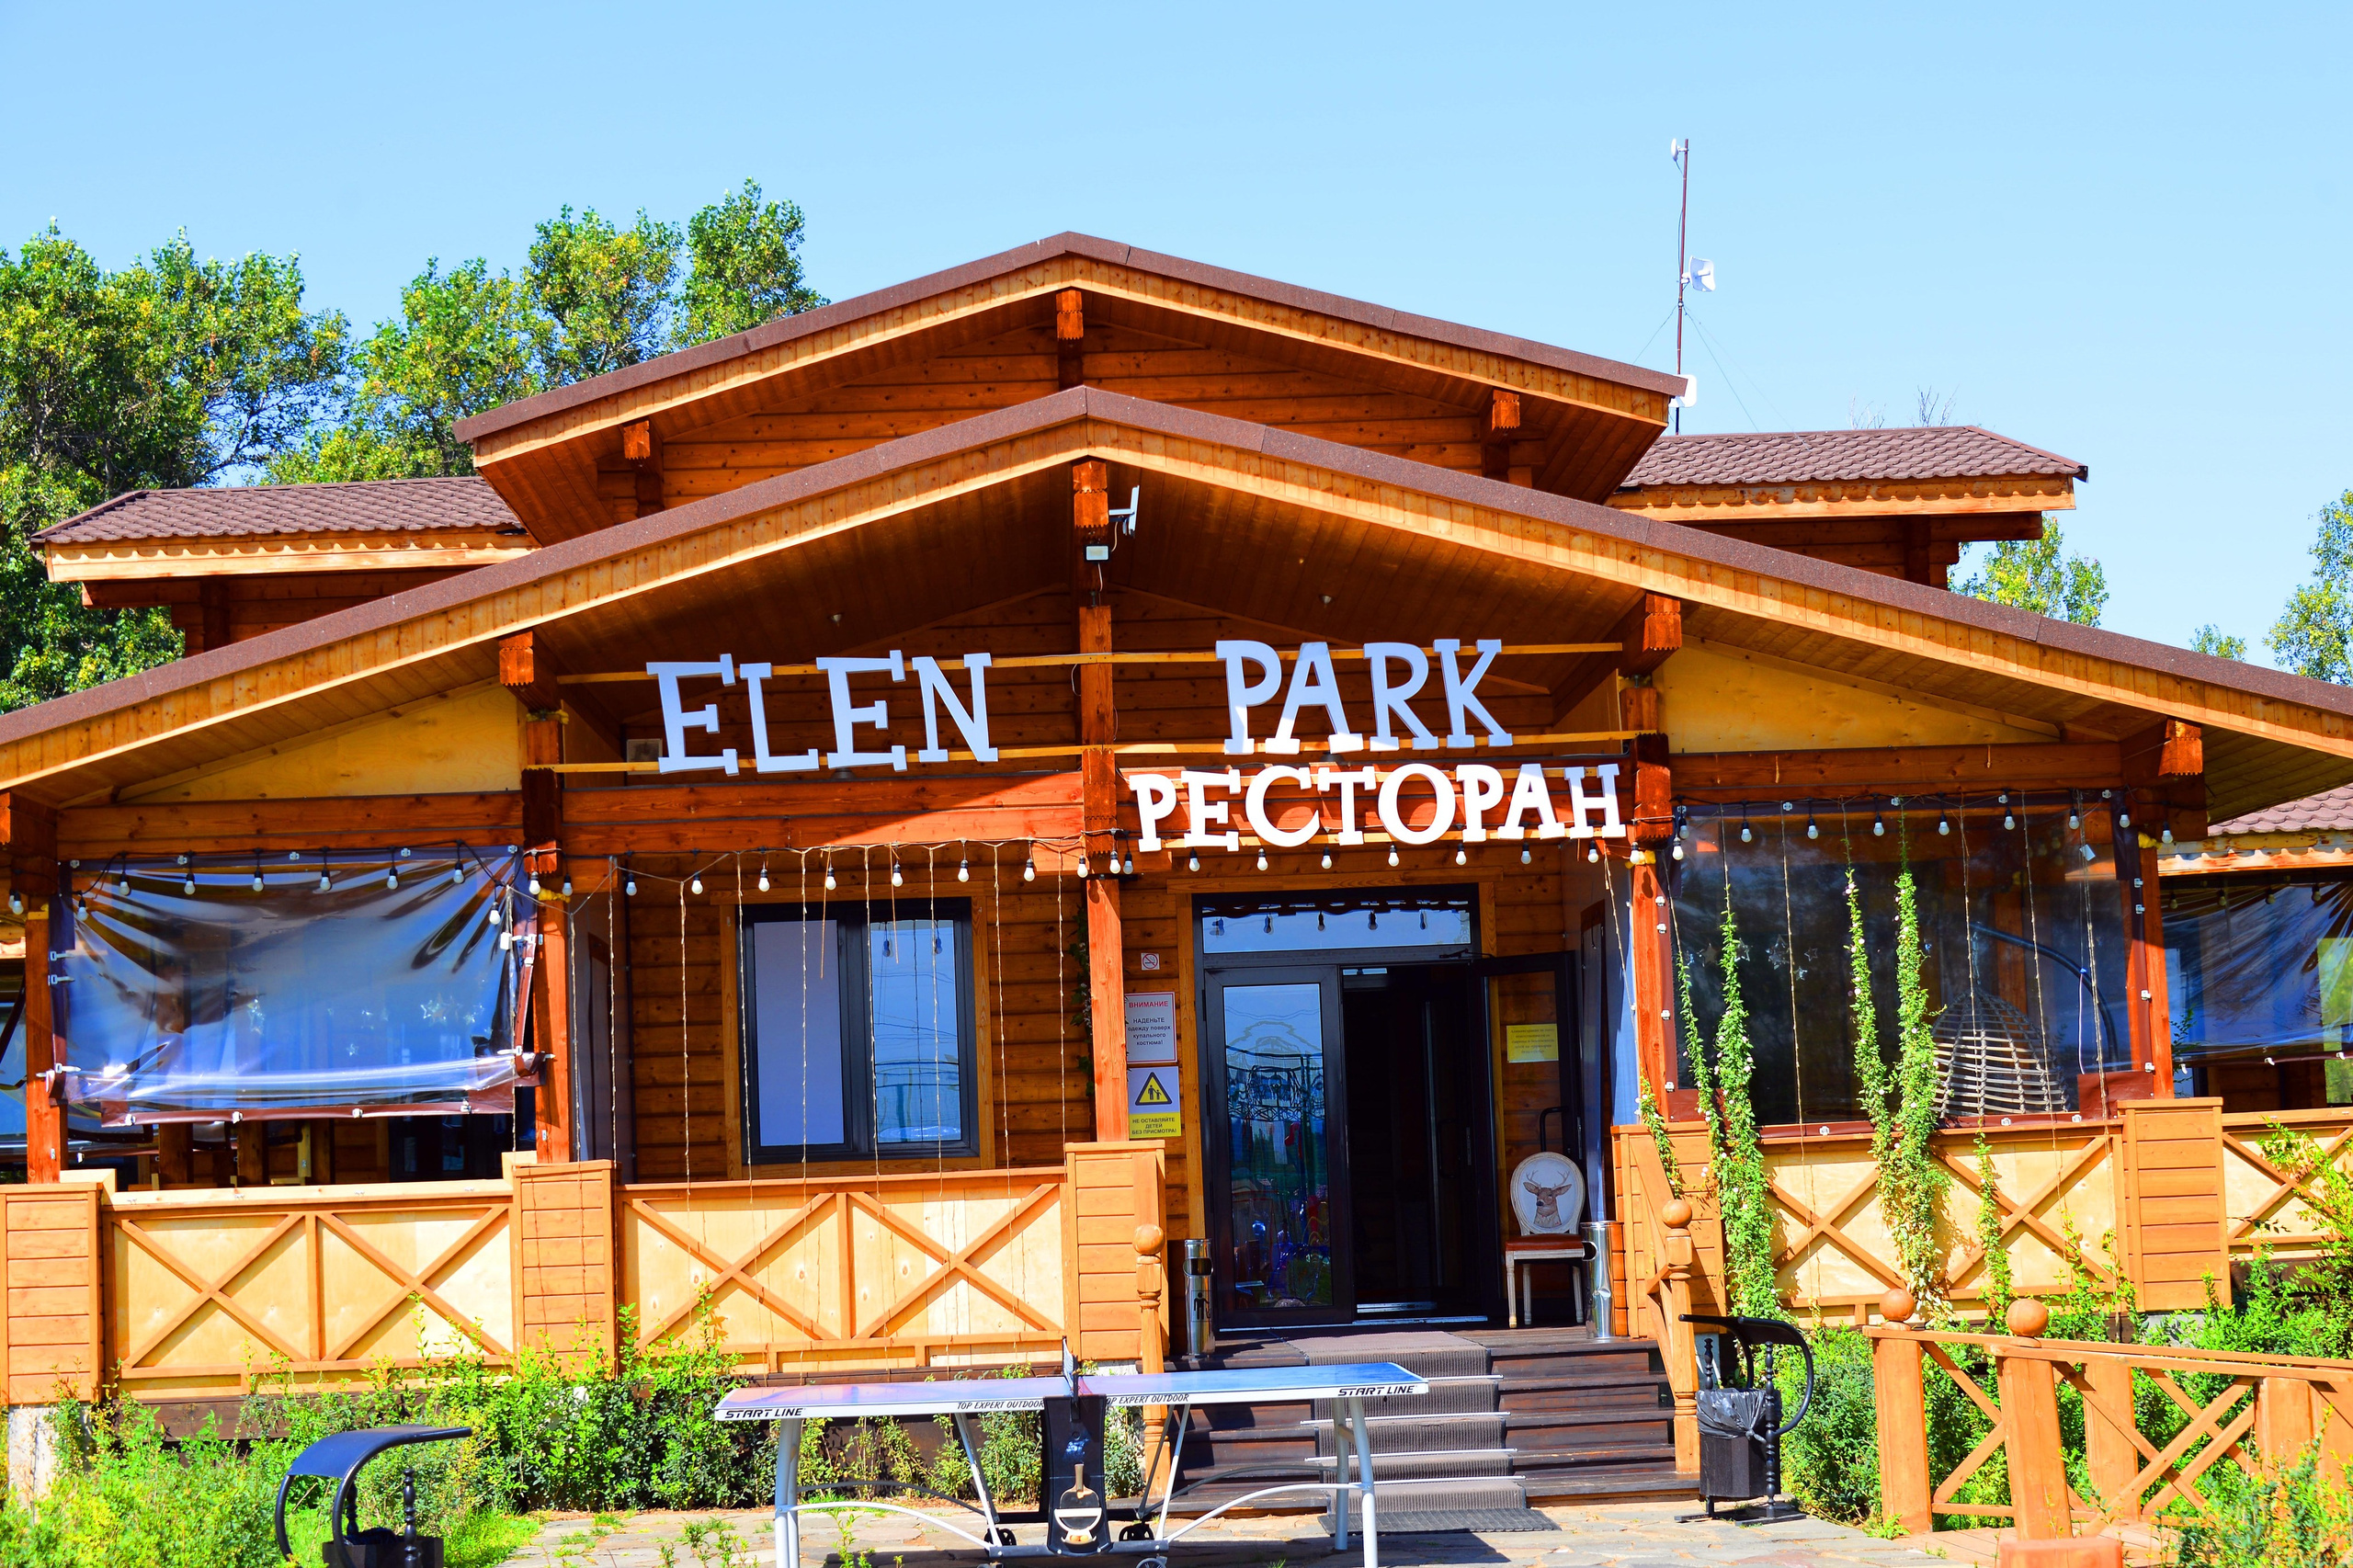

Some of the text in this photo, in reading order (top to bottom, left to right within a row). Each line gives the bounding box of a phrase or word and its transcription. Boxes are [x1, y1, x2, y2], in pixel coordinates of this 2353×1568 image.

[646, 639, 1512, 777] ELEN PARK
[1130, 763, 1626, 853] РЕСТОРАН
[1338, 1385, 1415, 1396] START LINE
[1119, 1396, 1149, 1404] EXPERT
[1151, 1393, 1189, 1403] OUTDOOR
[958, 1400, 1044, 1410] TOP EXPERT OUTDOOR
[725, 1407, 803, 1418] START LINE
